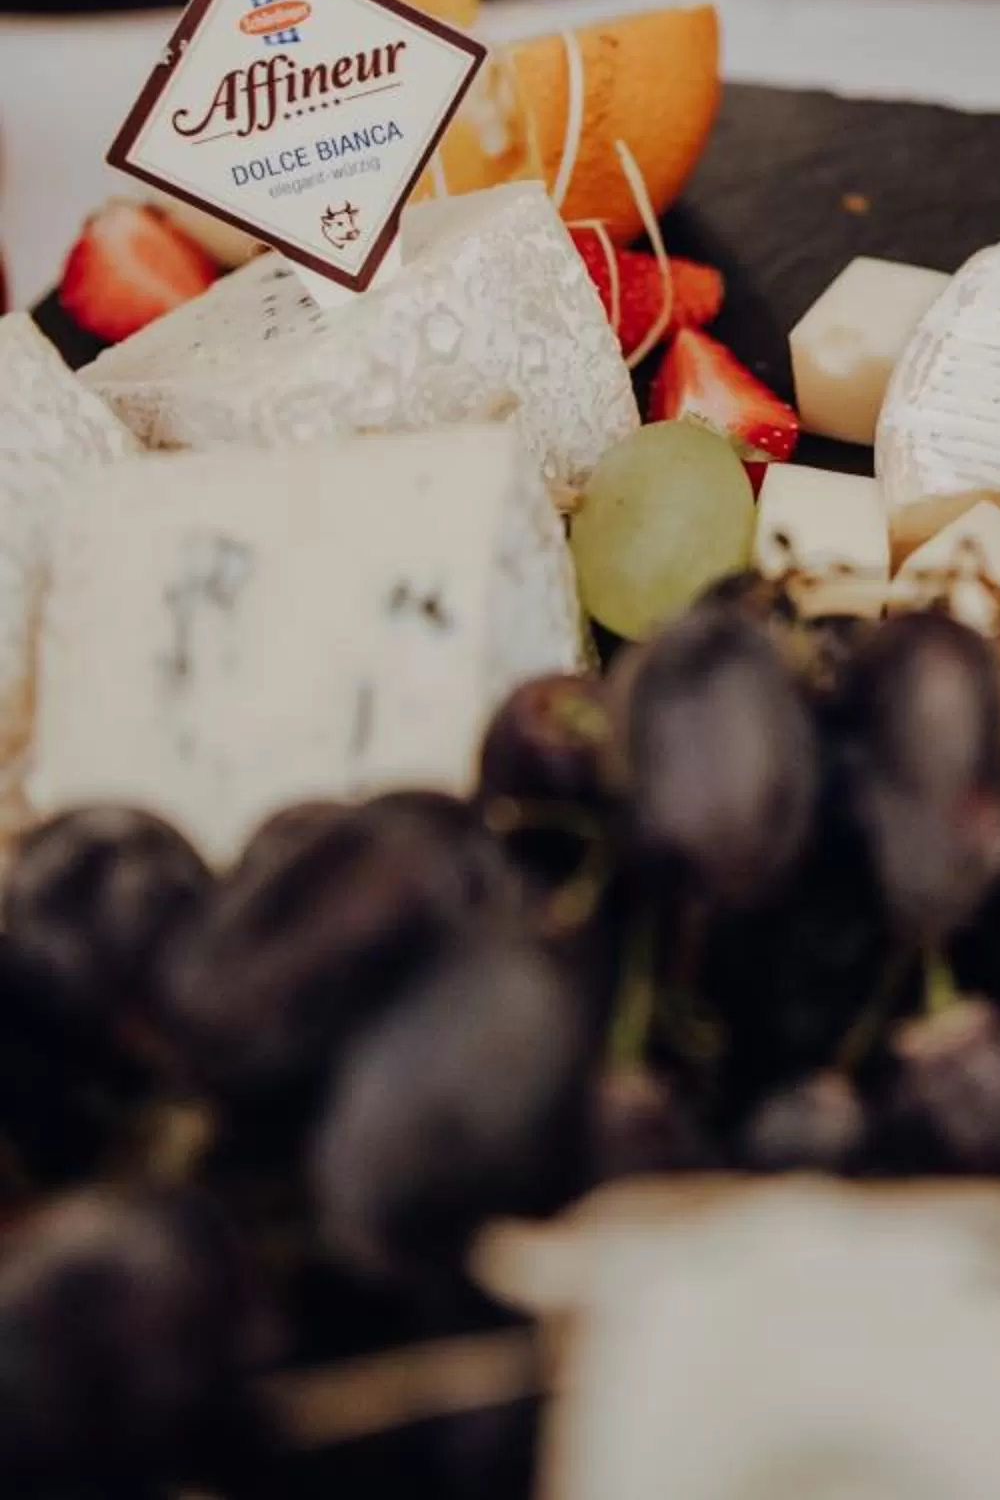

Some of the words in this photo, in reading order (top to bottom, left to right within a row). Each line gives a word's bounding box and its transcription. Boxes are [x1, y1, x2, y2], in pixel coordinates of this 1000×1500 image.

[173, 42, 406, 137] Affineur
[231, 147, 310, 186] DOLCE
[315, 121, 404, 161] BIANCA
